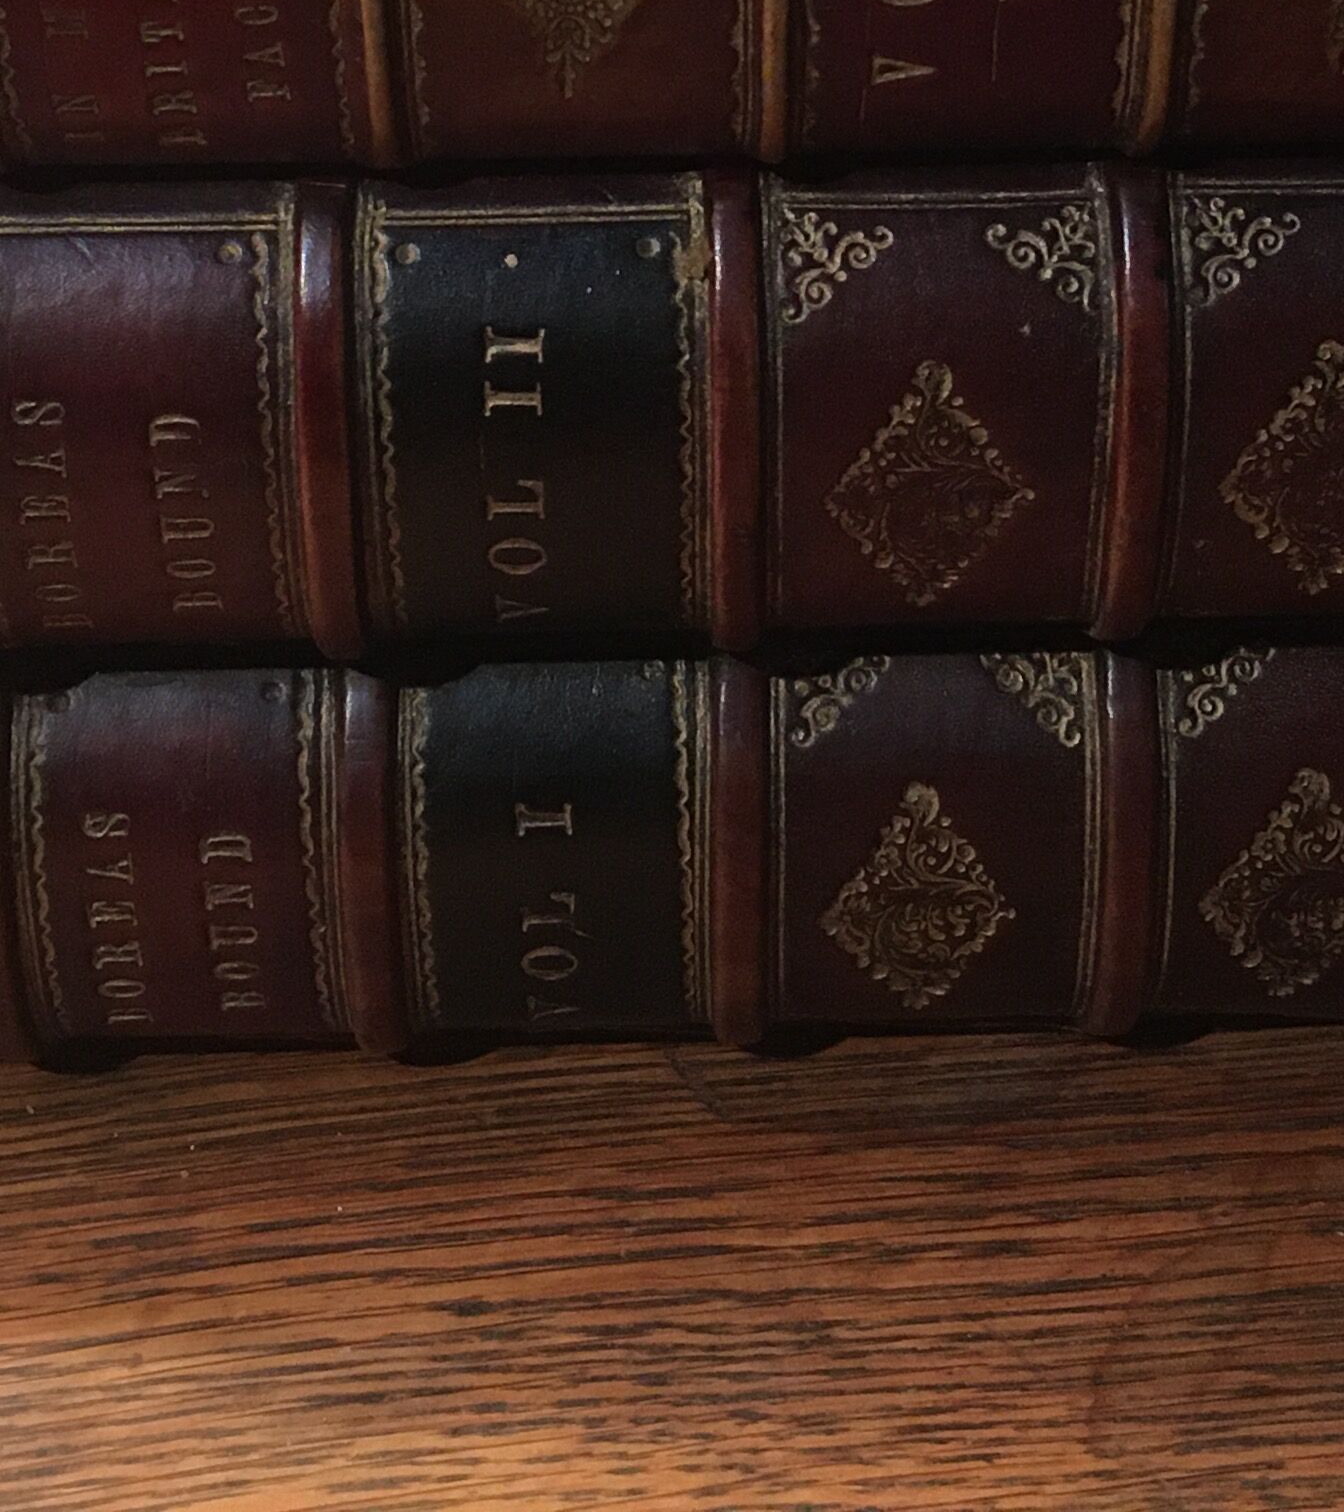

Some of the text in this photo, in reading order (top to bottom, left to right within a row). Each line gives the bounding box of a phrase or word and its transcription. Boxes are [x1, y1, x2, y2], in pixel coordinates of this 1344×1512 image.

[483, 325, 550, 622] VOL II
[198, 830, 266, 1012] BOUND
[514, 801, 582, 1022] VOL I
